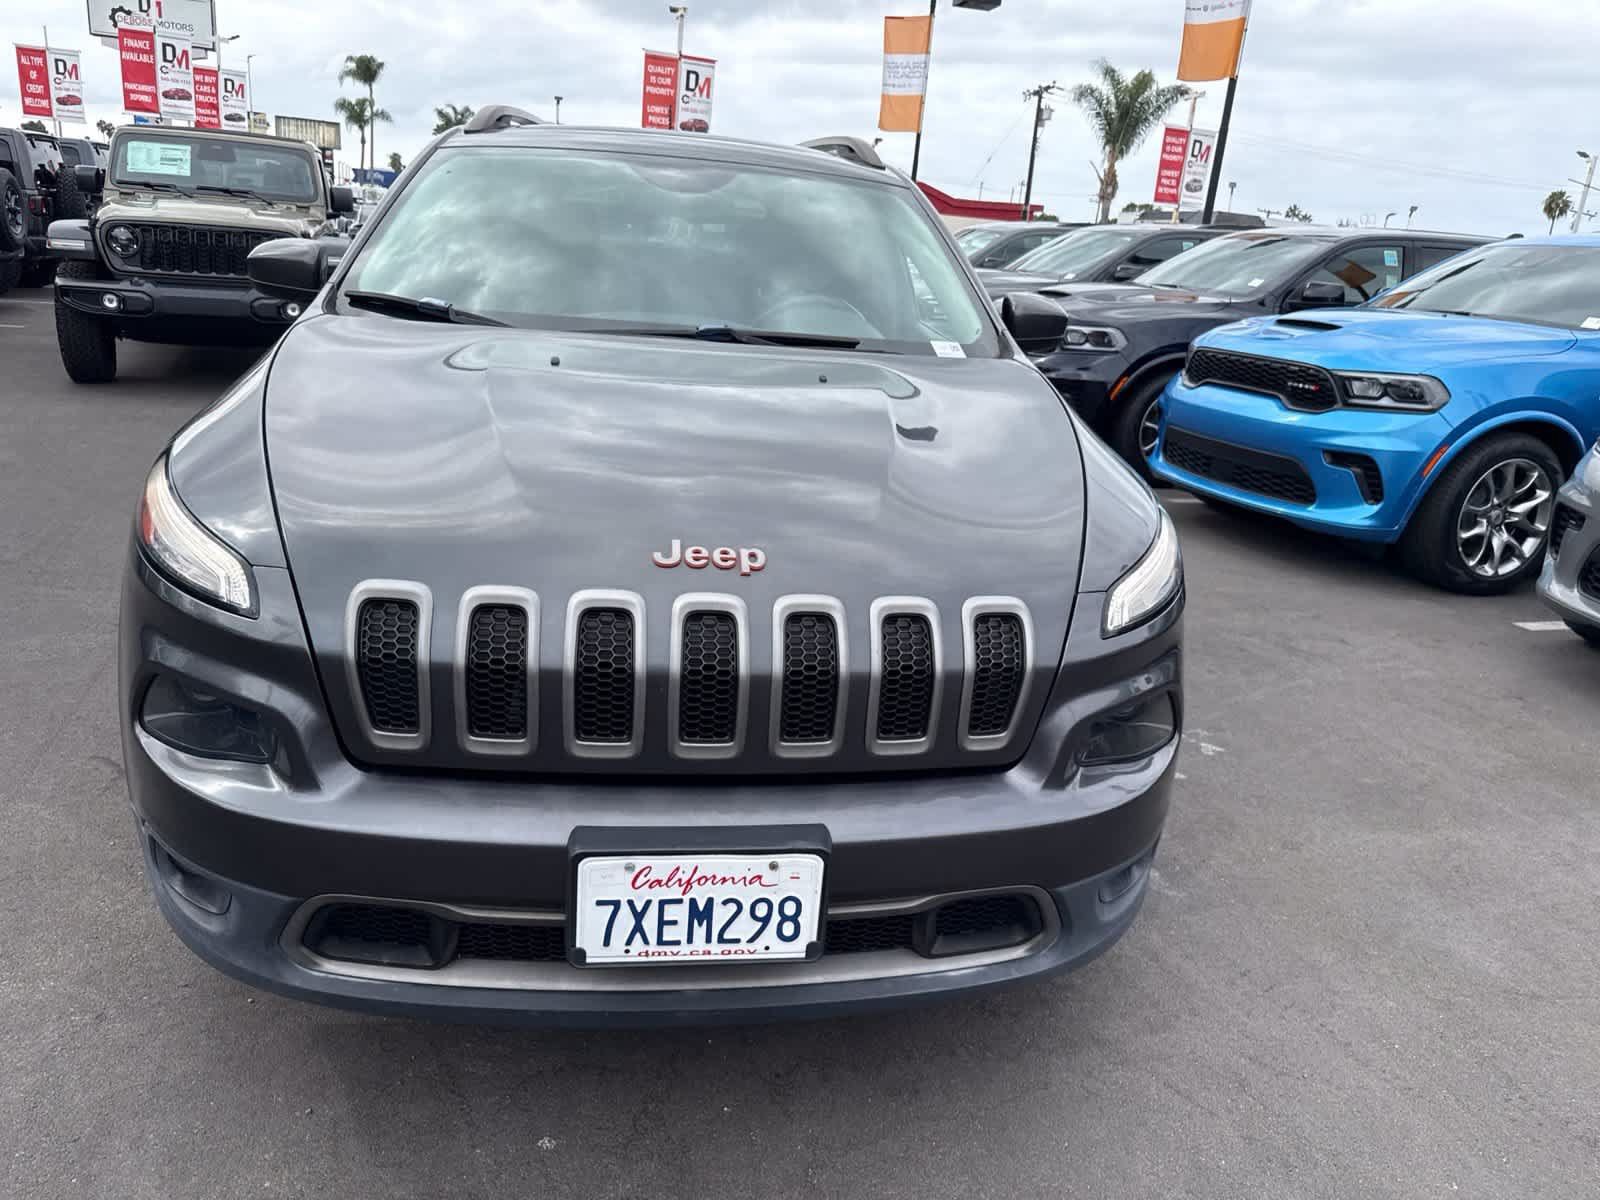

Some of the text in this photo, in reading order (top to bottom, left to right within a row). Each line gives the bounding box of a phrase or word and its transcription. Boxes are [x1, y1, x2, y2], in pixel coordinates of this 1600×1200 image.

[156, 20, 194, 32] MOTORS
[124, 38, 150, 50] FINANCE
[21, 56, 43, 66] ALL TYPE
[122, 51, 154, 64] AVAILABLE
[648, 64, 675, 75] QUALITY
[650, 75, 672, 86] IS OUR
[26, 84, 44, 94] CREDIT
[646, 86, 675, 96] PRIORITY
[196, 94, 216, 104] TRUCKS
[652, 539, 767, 576] Jeep
[632, 864, 777, 896] California
[596, 896, 802, 947] 7XEM298
[638, 948, 758, 958] dmv.ca.gov
